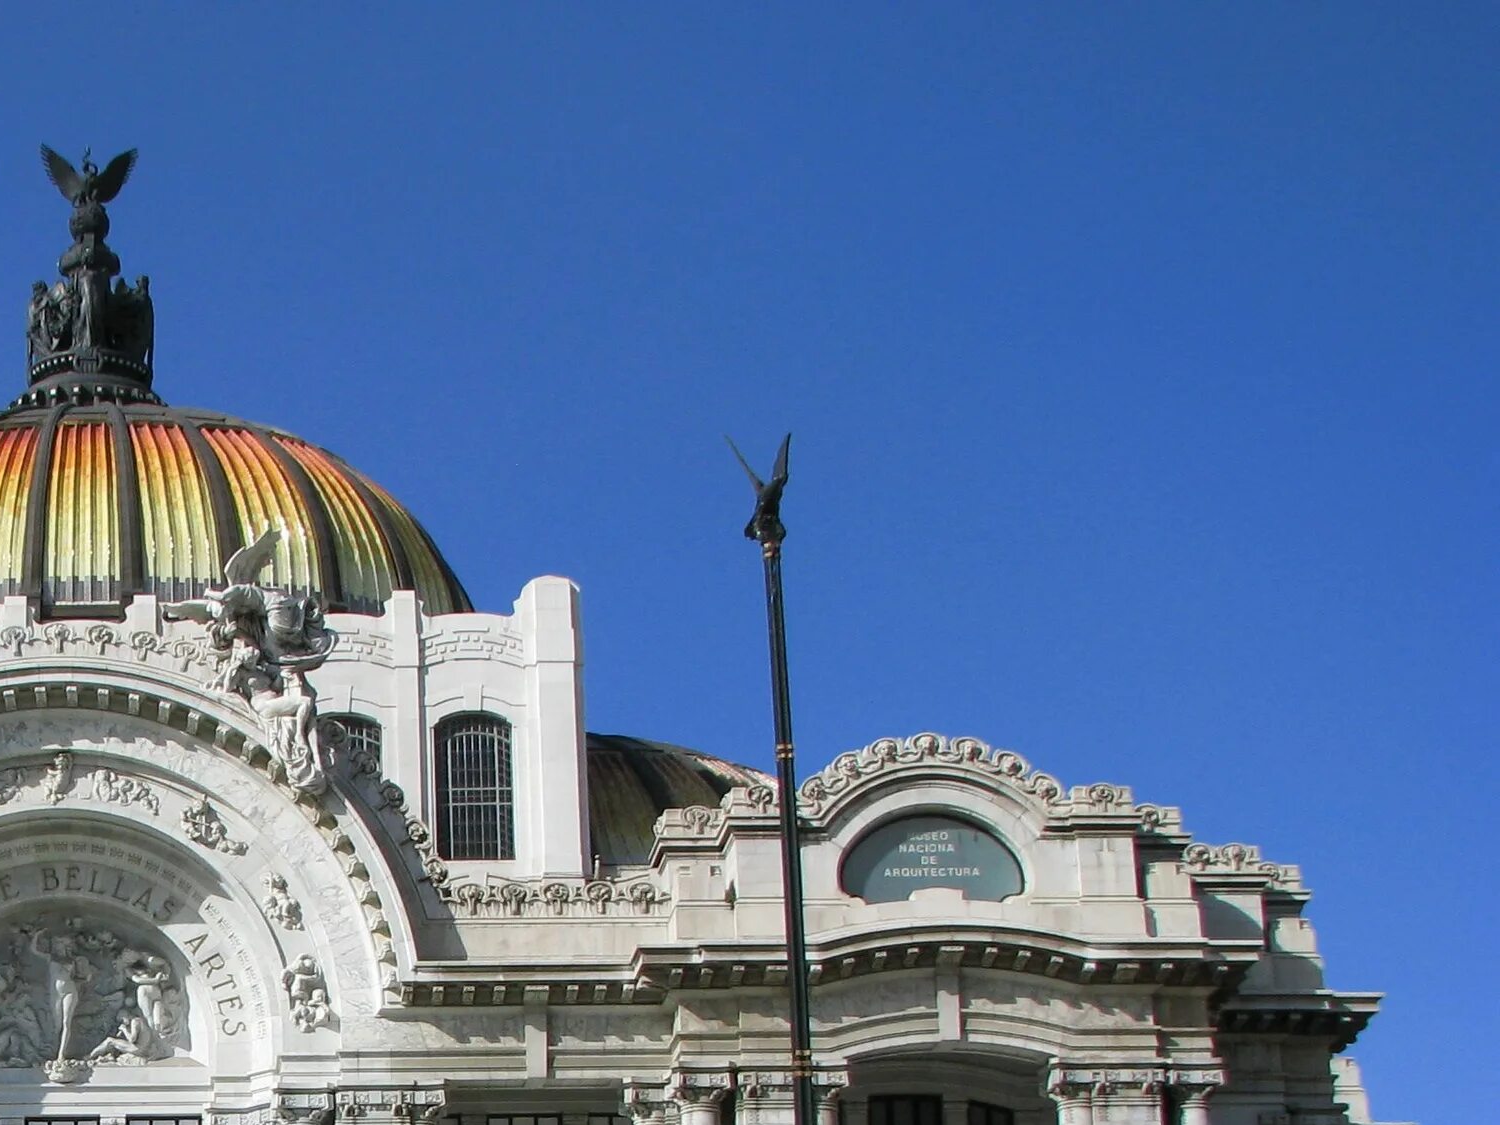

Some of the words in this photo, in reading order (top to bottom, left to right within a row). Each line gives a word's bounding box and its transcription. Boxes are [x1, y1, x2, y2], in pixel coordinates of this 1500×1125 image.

[898, 843, 955, 854] NACIONA
[920, 855, 938, 865] DE
[883, 867, 980, 877] ARQUITECTURA
[41, 865, 176, 922] BELLAS
[183, 932, 247, 1038] ARTES
